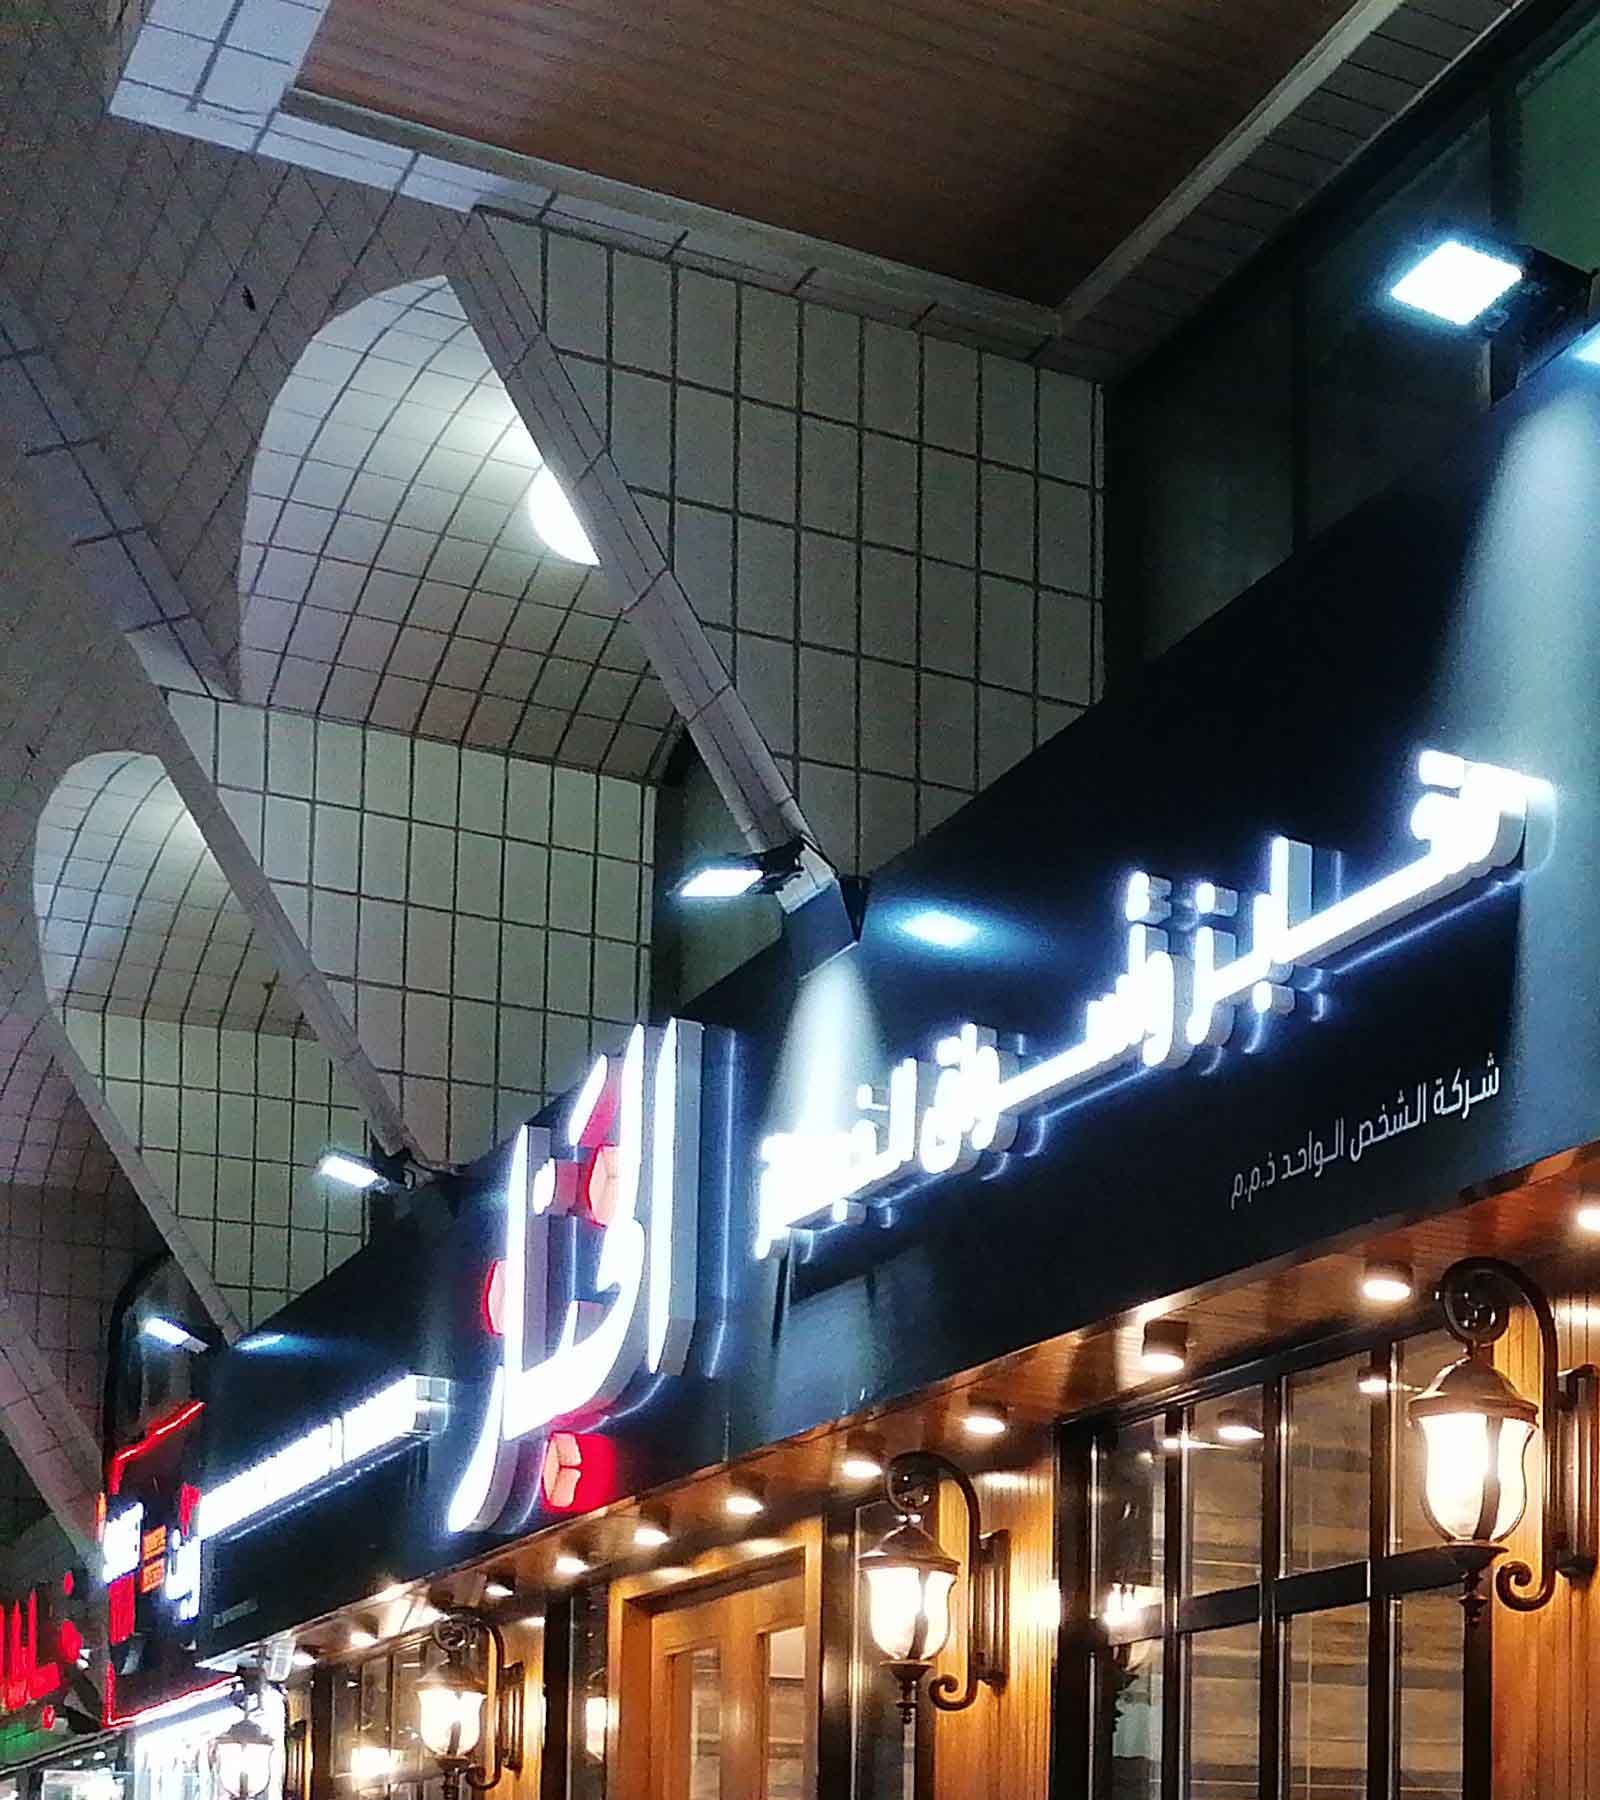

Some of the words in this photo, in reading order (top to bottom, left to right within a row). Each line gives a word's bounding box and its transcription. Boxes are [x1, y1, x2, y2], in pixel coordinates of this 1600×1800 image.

[1432, 1050, 1501, 1120] شركة
[1280, 1116, 1345, 1182] الواحد
[1349, 1082, 1429, 1162] الشخص
[1230, 1151, 1276, 1210] ذ.م.م
